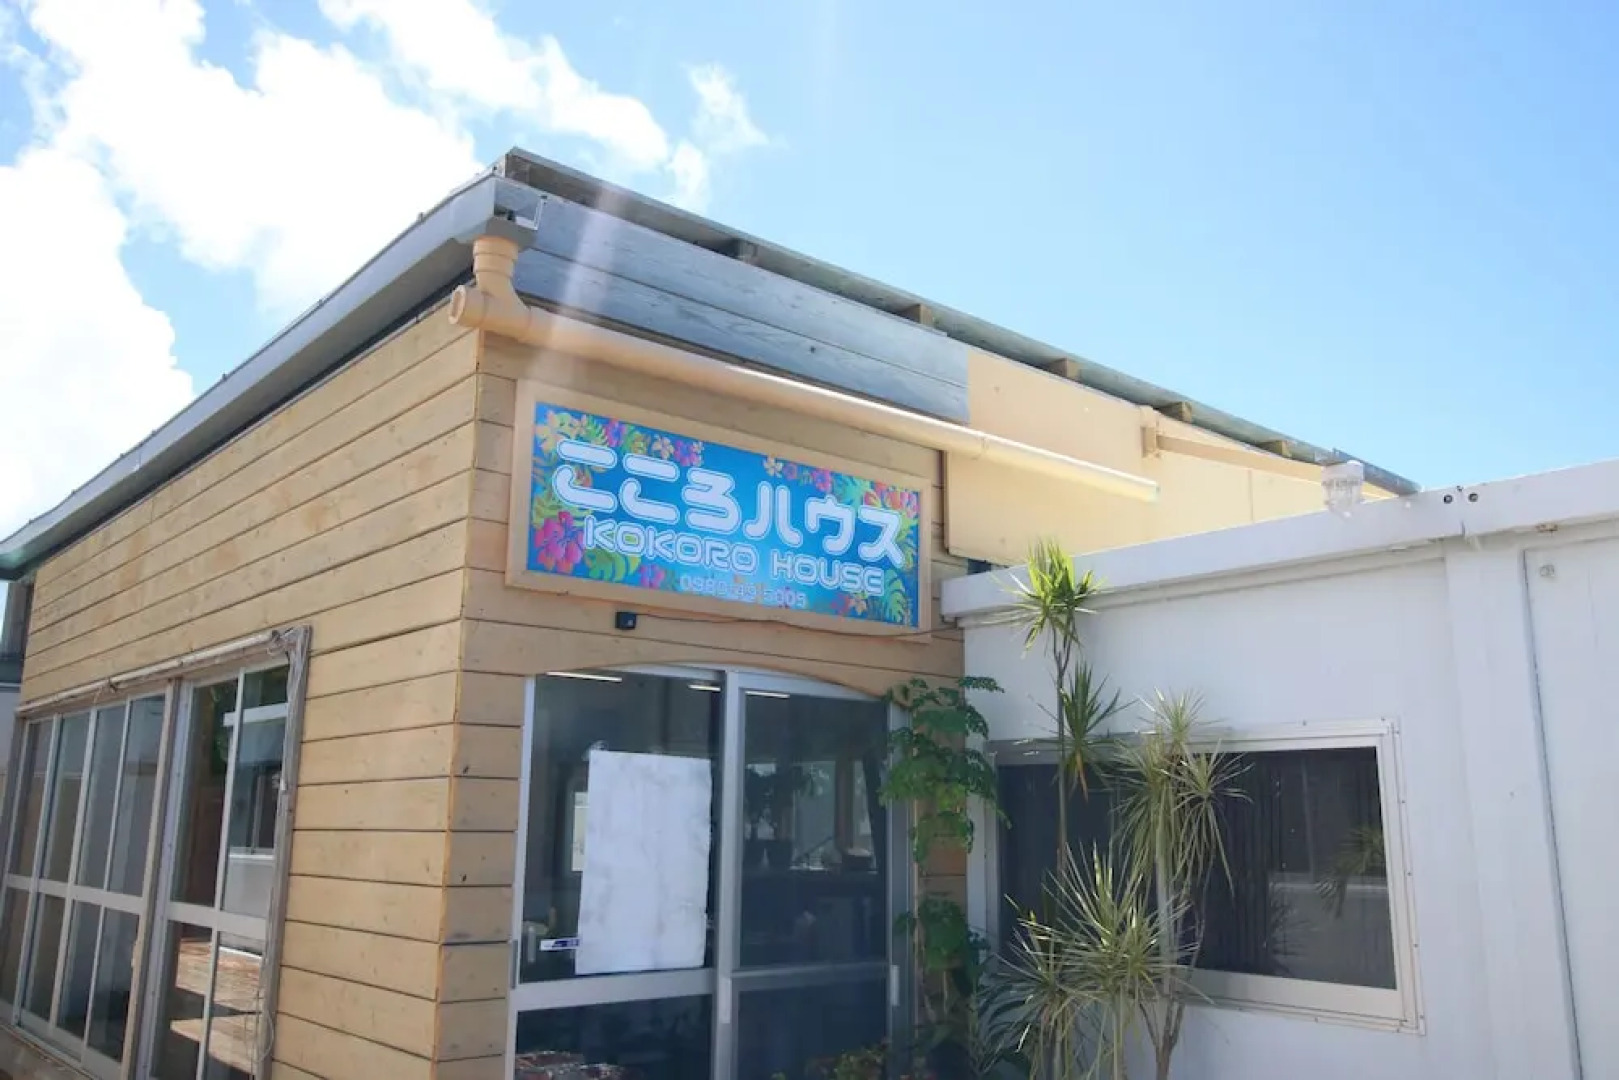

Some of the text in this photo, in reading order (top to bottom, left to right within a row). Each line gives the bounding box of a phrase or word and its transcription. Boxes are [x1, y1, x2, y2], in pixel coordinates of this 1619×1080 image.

[553, 439, 904, 567] こころハウス
[584, 516, 884, 596] KOKORO HOUSE
